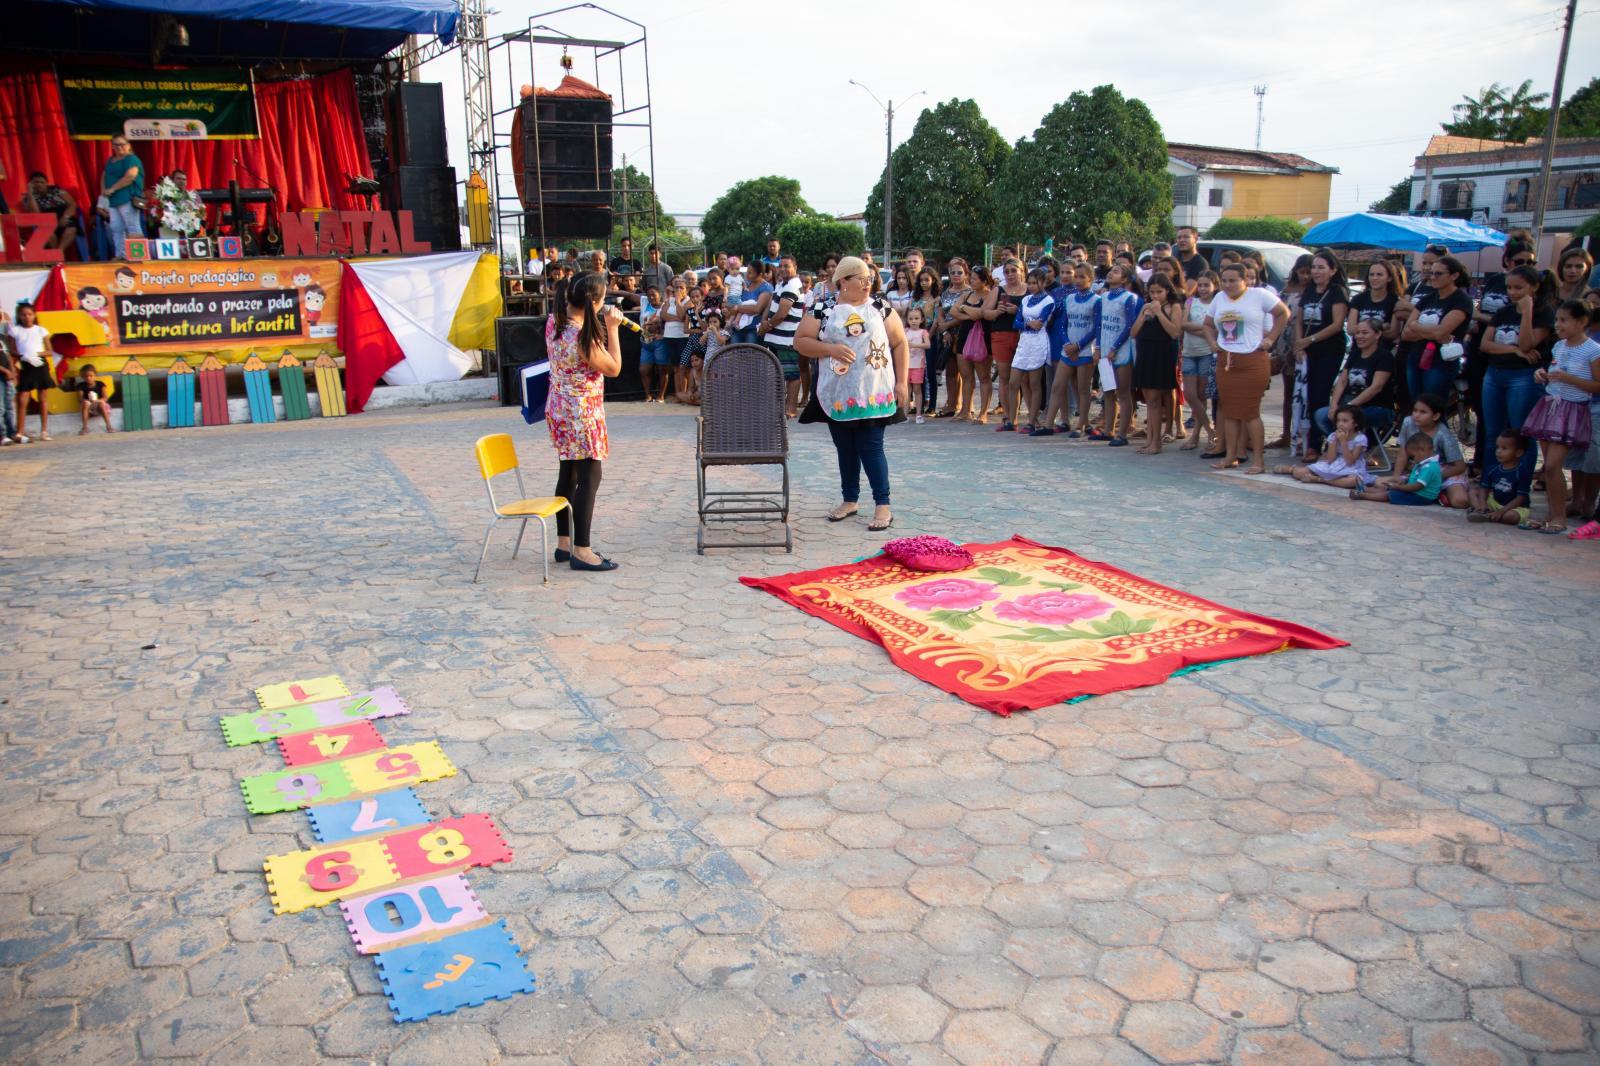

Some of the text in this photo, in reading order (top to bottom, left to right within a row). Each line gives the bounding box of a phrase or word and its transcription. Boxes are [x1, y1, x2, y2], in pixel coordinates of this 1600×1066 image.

[129, 128, 160, 137] SEMED
[0, 212, 65, 263] IZ
[281, 210, 432, 256] NATAL
[141, 268, 256, 288] Projeto pedagógico
[121, 296, 293, 318] Despertando o prazer pela
[125, 314, 296, 339] Literatura Infantil
[309, 732, 351, 757] 4
[375, 753, 421, 780] 5
[276, 773, 323, 801] 6
[351, 799, 398, 832] 7
[418, 828, 471, 864] 8
[364, 885, 463, 934] 10
